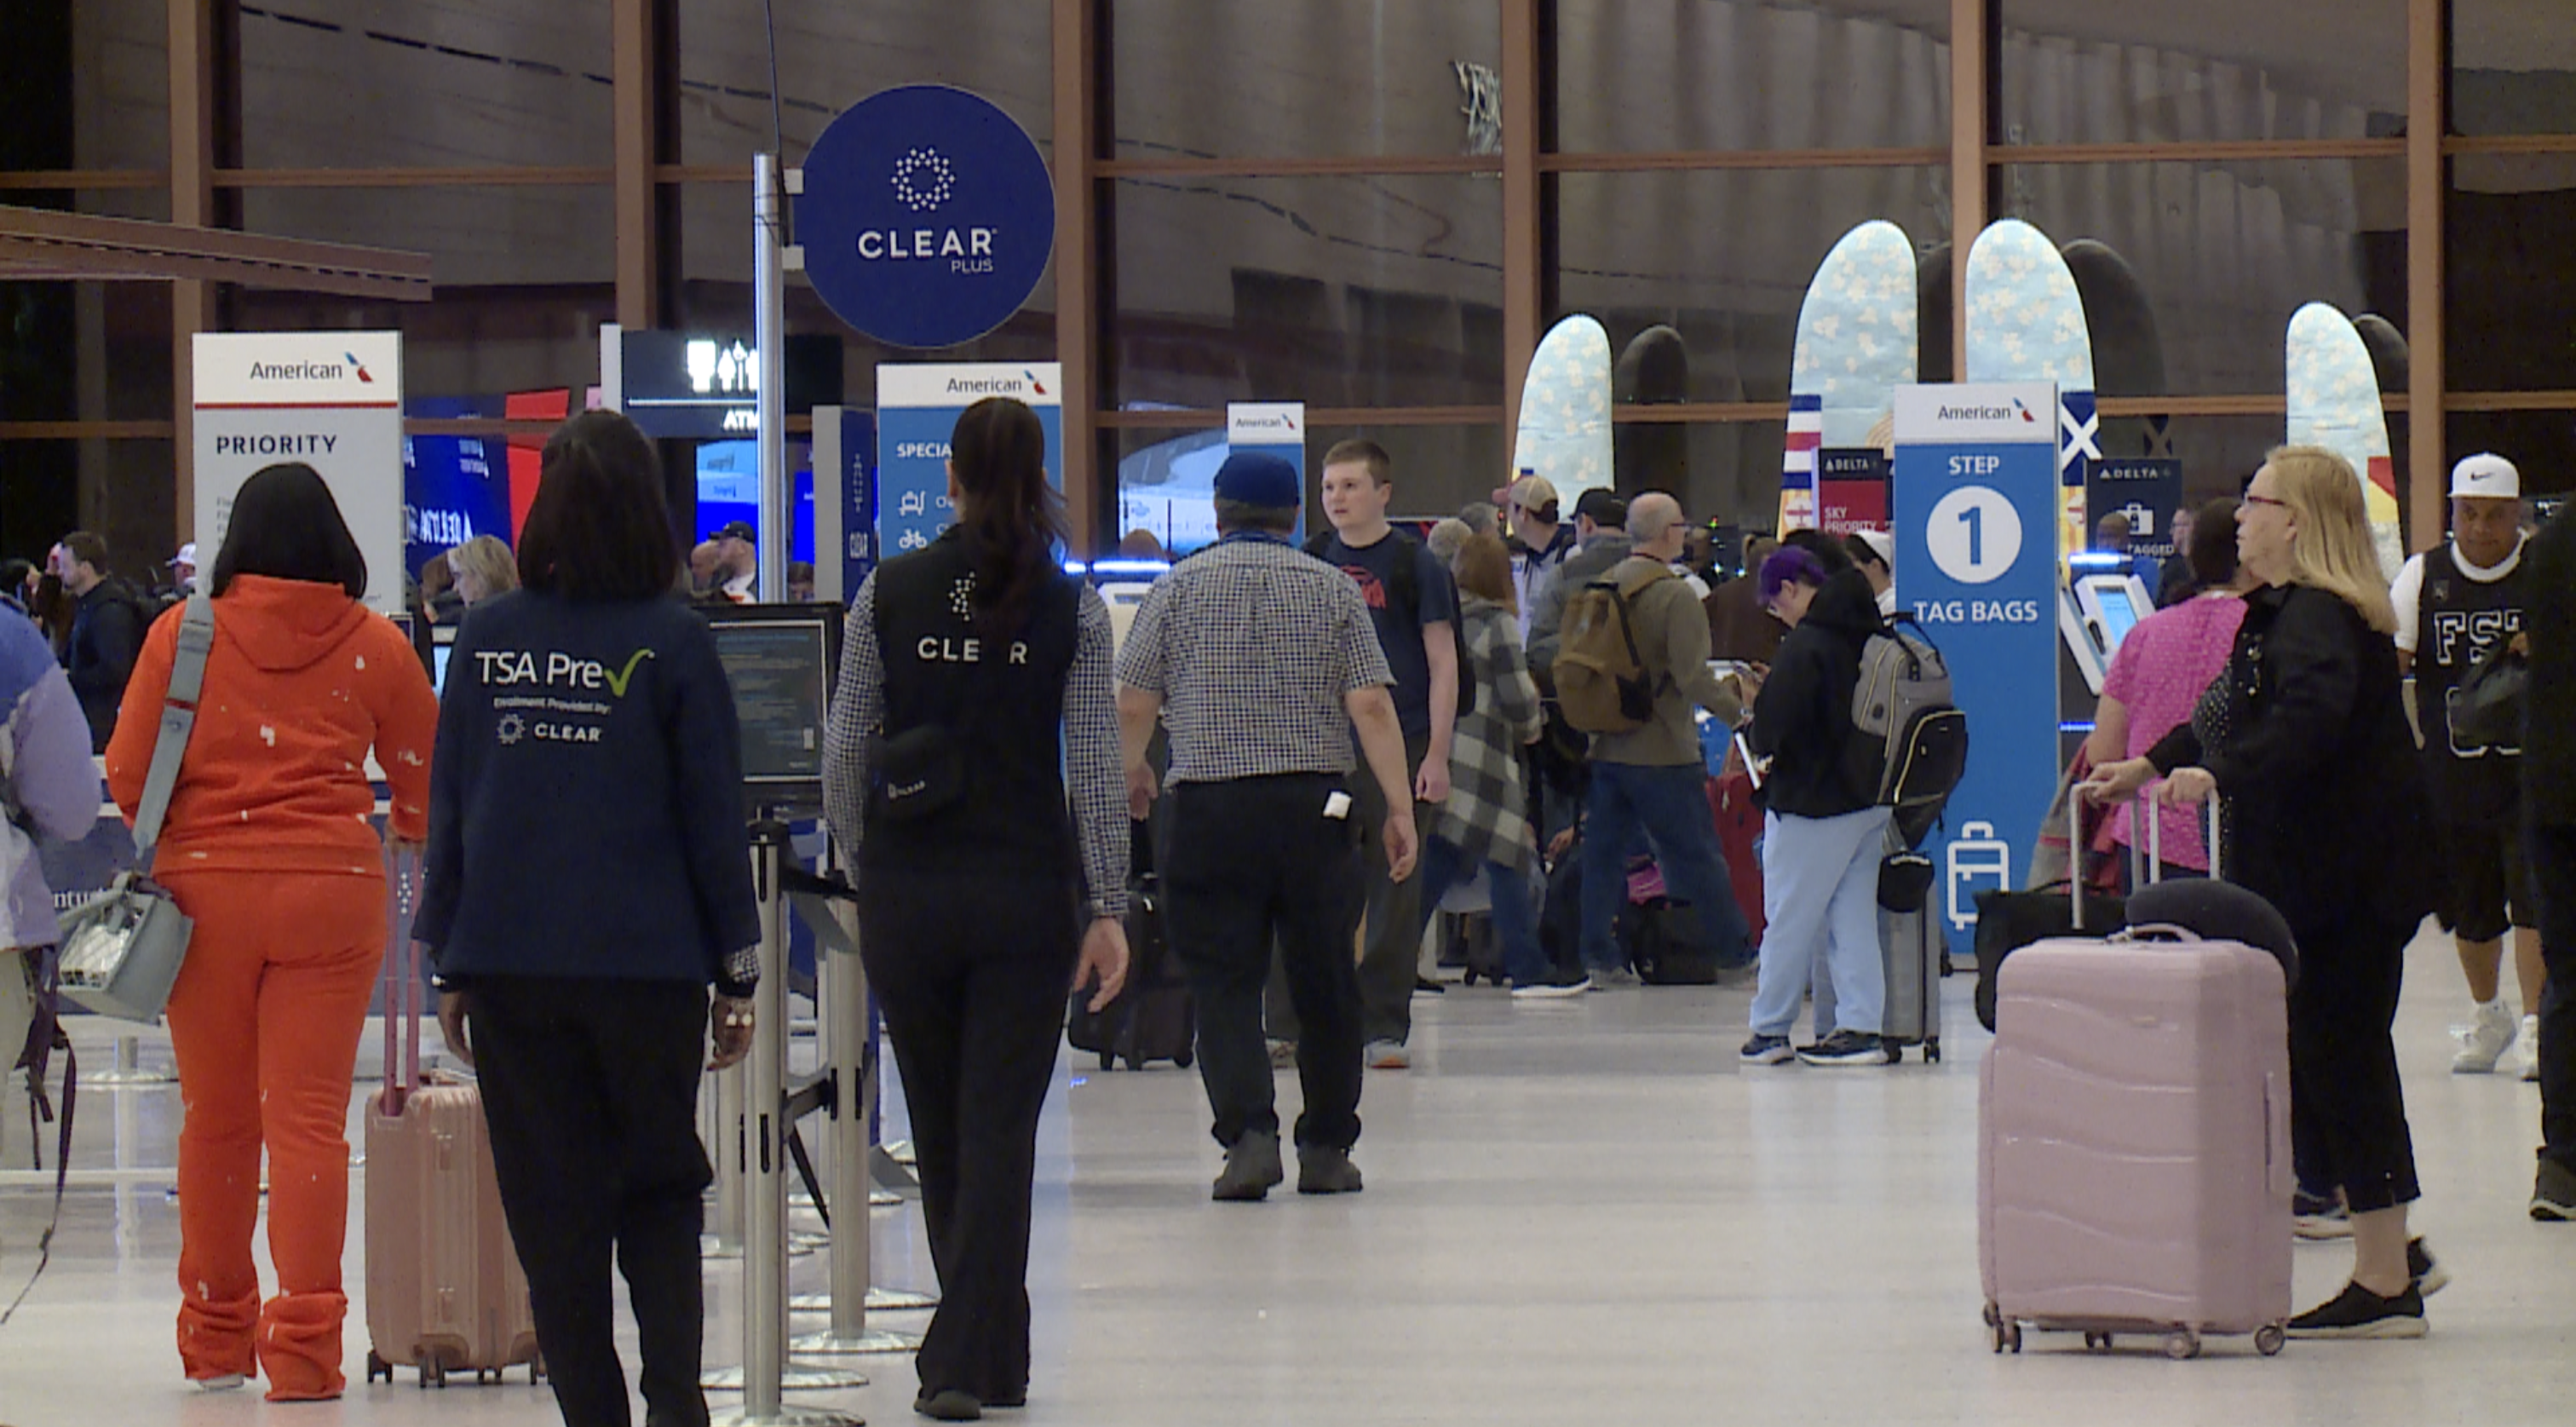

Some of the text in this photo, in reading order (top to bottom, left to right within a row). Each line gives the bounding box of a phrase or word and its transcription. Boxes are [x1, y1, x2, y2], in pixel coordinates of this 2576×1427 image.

[858, 227, 992, 259] CLEAR
[951, 258, 993, 273] PLUS
[250, 360, 342, 380] American
[946, 377, 1021, 394] American
[1937, 405, 2011, 420] American
[1235, 417, 1281, 429] American
[216, 434, 337, 455] PRIORITY
[896, 442, 952, 458] SPECIA
[1835, 457, 1869, 471] DELTA
[1948, 455, 2000, 475] STEP
[2113, 468, 2158, 479] DELTA
[1824, 506, 1847, 519] SKY
[1958, 506, 1981, 566] 1
[1913, 600, 2038, 623] TAG BAGS
[2434, 609, 2523, 665] FS
[917, 637, 1028, 665] CLER
[474, 651, 603, 688] TSA Pre
[533, 722, 601, 742] CLEAR
